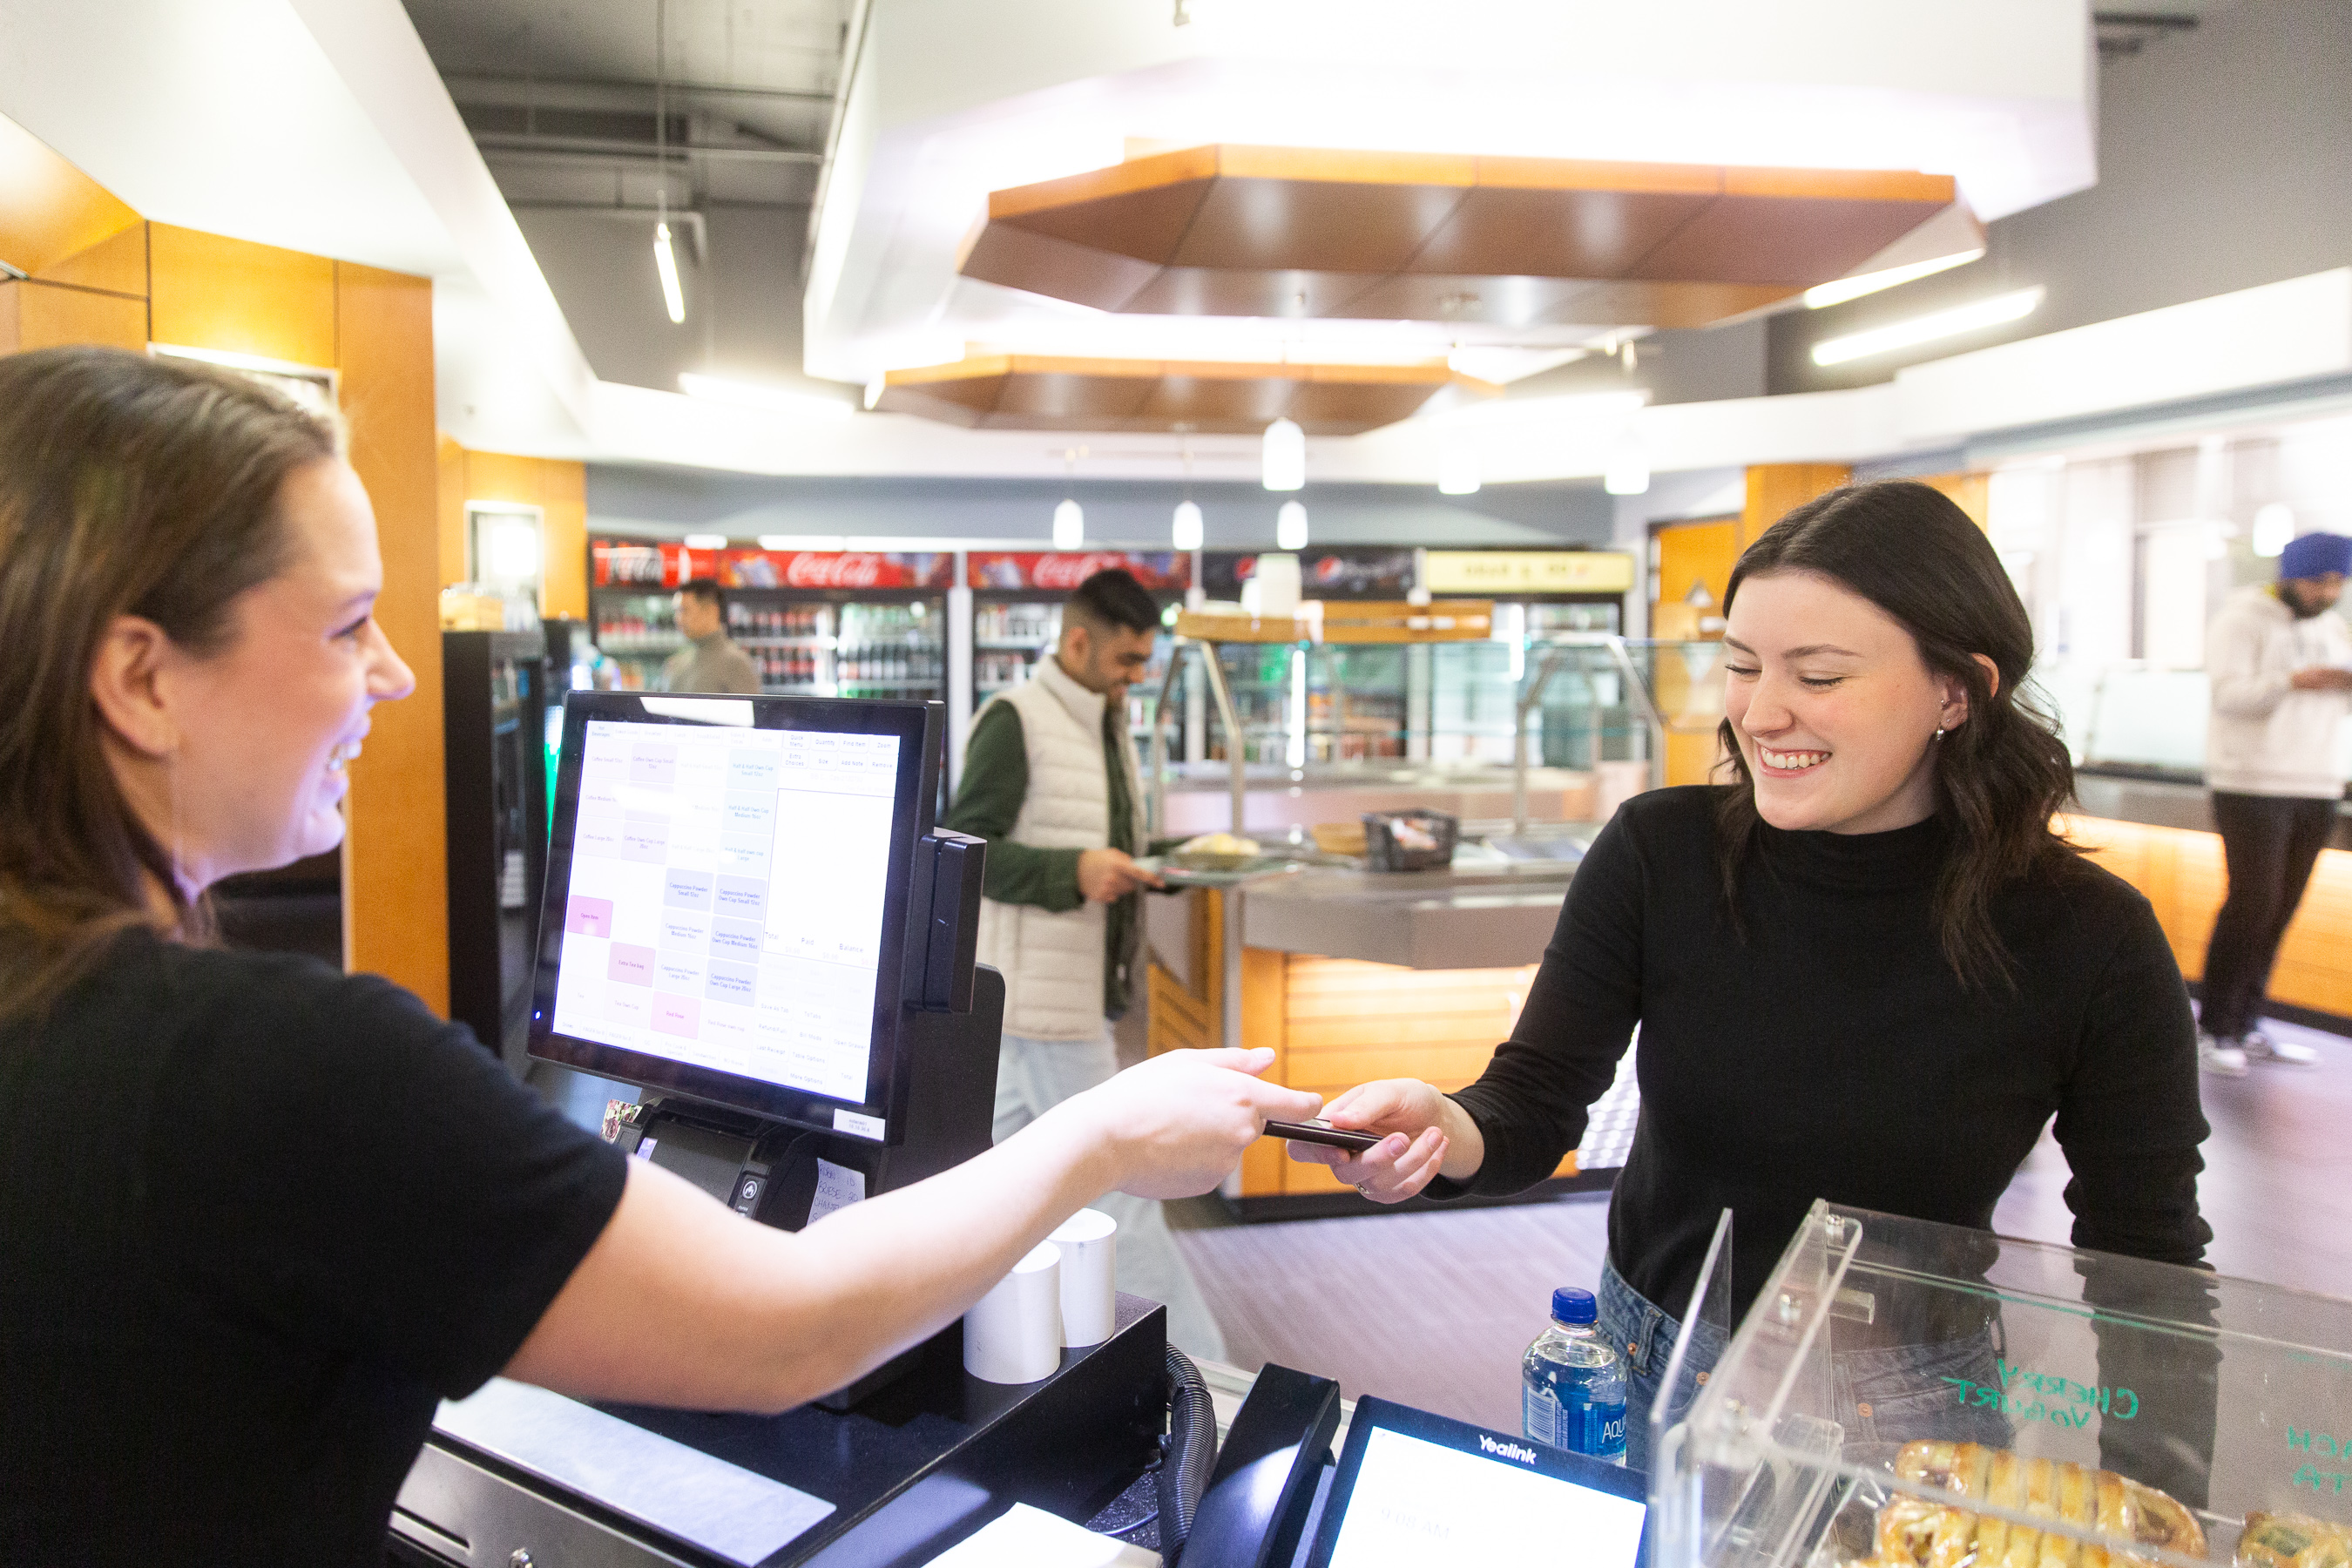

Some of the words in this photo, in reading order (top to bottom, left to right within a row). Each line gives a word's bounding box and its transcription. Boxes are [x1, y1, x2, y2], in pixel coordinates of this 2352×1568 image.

[669, 882, 692, 890] Cappuccino
[720, 889, 743, 897] Cappuccino
[666, 923, 687, 932] Cappuccino
[715, 930, 740, 940] Cappuccino
[765, 931, 779, 940] Total
[801, 937, 814, 946] Paid
[839, 943, 863, 953] Balance
[661, 964, 683, 973] Cappuccino
[711, 973, 734, 983] Cappuccino
[728, 983, 740, 991] Large
[767, 1046, 786, 1056] Receipt
[806, 1054, 826, 1064] Options
[804, 1075, 823, 1085] Options
[1480, 1435, 1536, 1464] Yealink
[1421, 1520, 1450, 1540] AM
